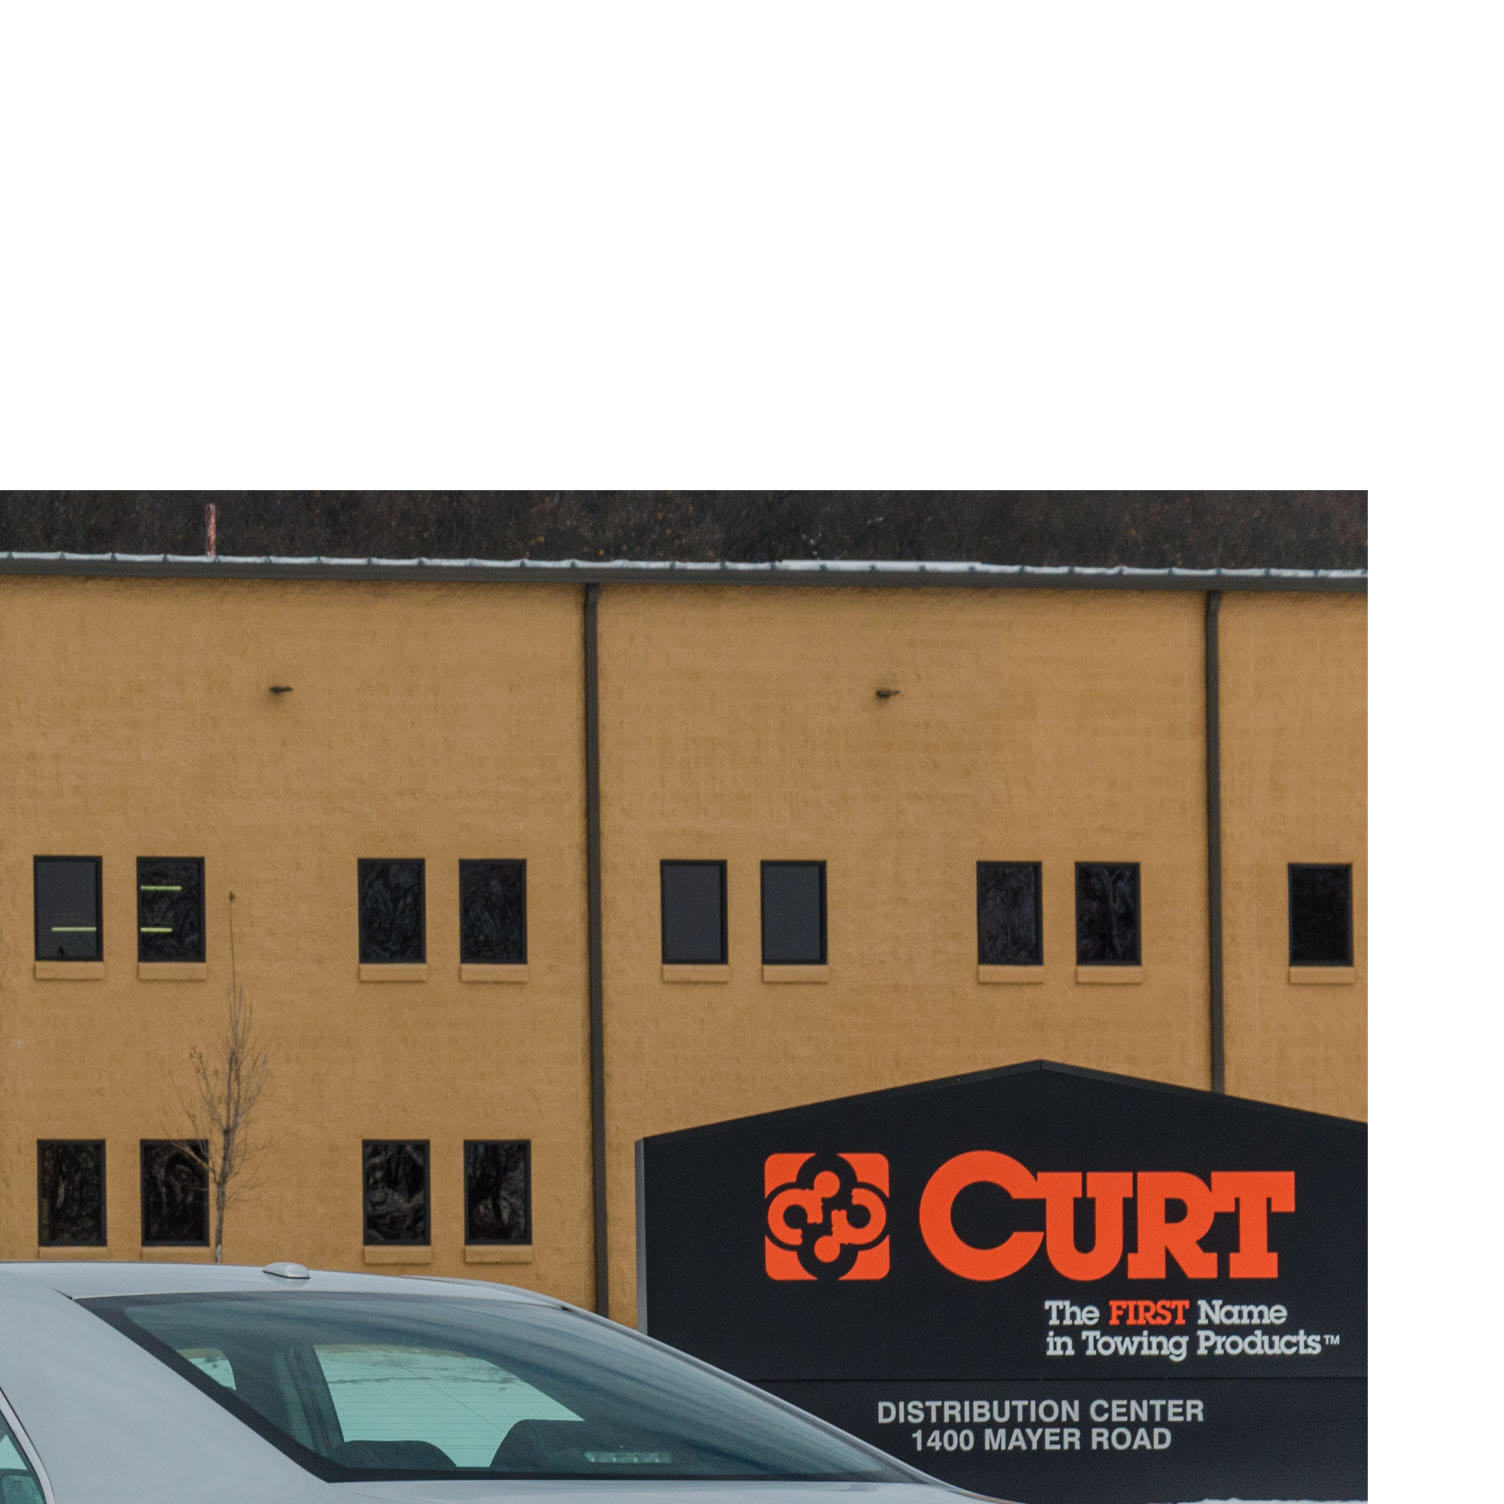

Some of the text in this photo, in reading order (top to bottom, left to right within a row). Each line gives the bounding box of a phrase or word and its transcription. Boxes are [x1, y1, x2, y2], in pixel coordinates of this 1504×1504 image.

[918, 1149, 1296, 1282] CURT
[1044, 1299, 1288, 1326] The FIRST Name
[1046, 1330, 1075, 1356] in
[1081, 1330, 1190, 1362] Towing
[877, 1399, 1205, 1424] DISTRIBUTION CENTER
[912, 1427, 1172, 1452] 1400 MAYER ROAD
